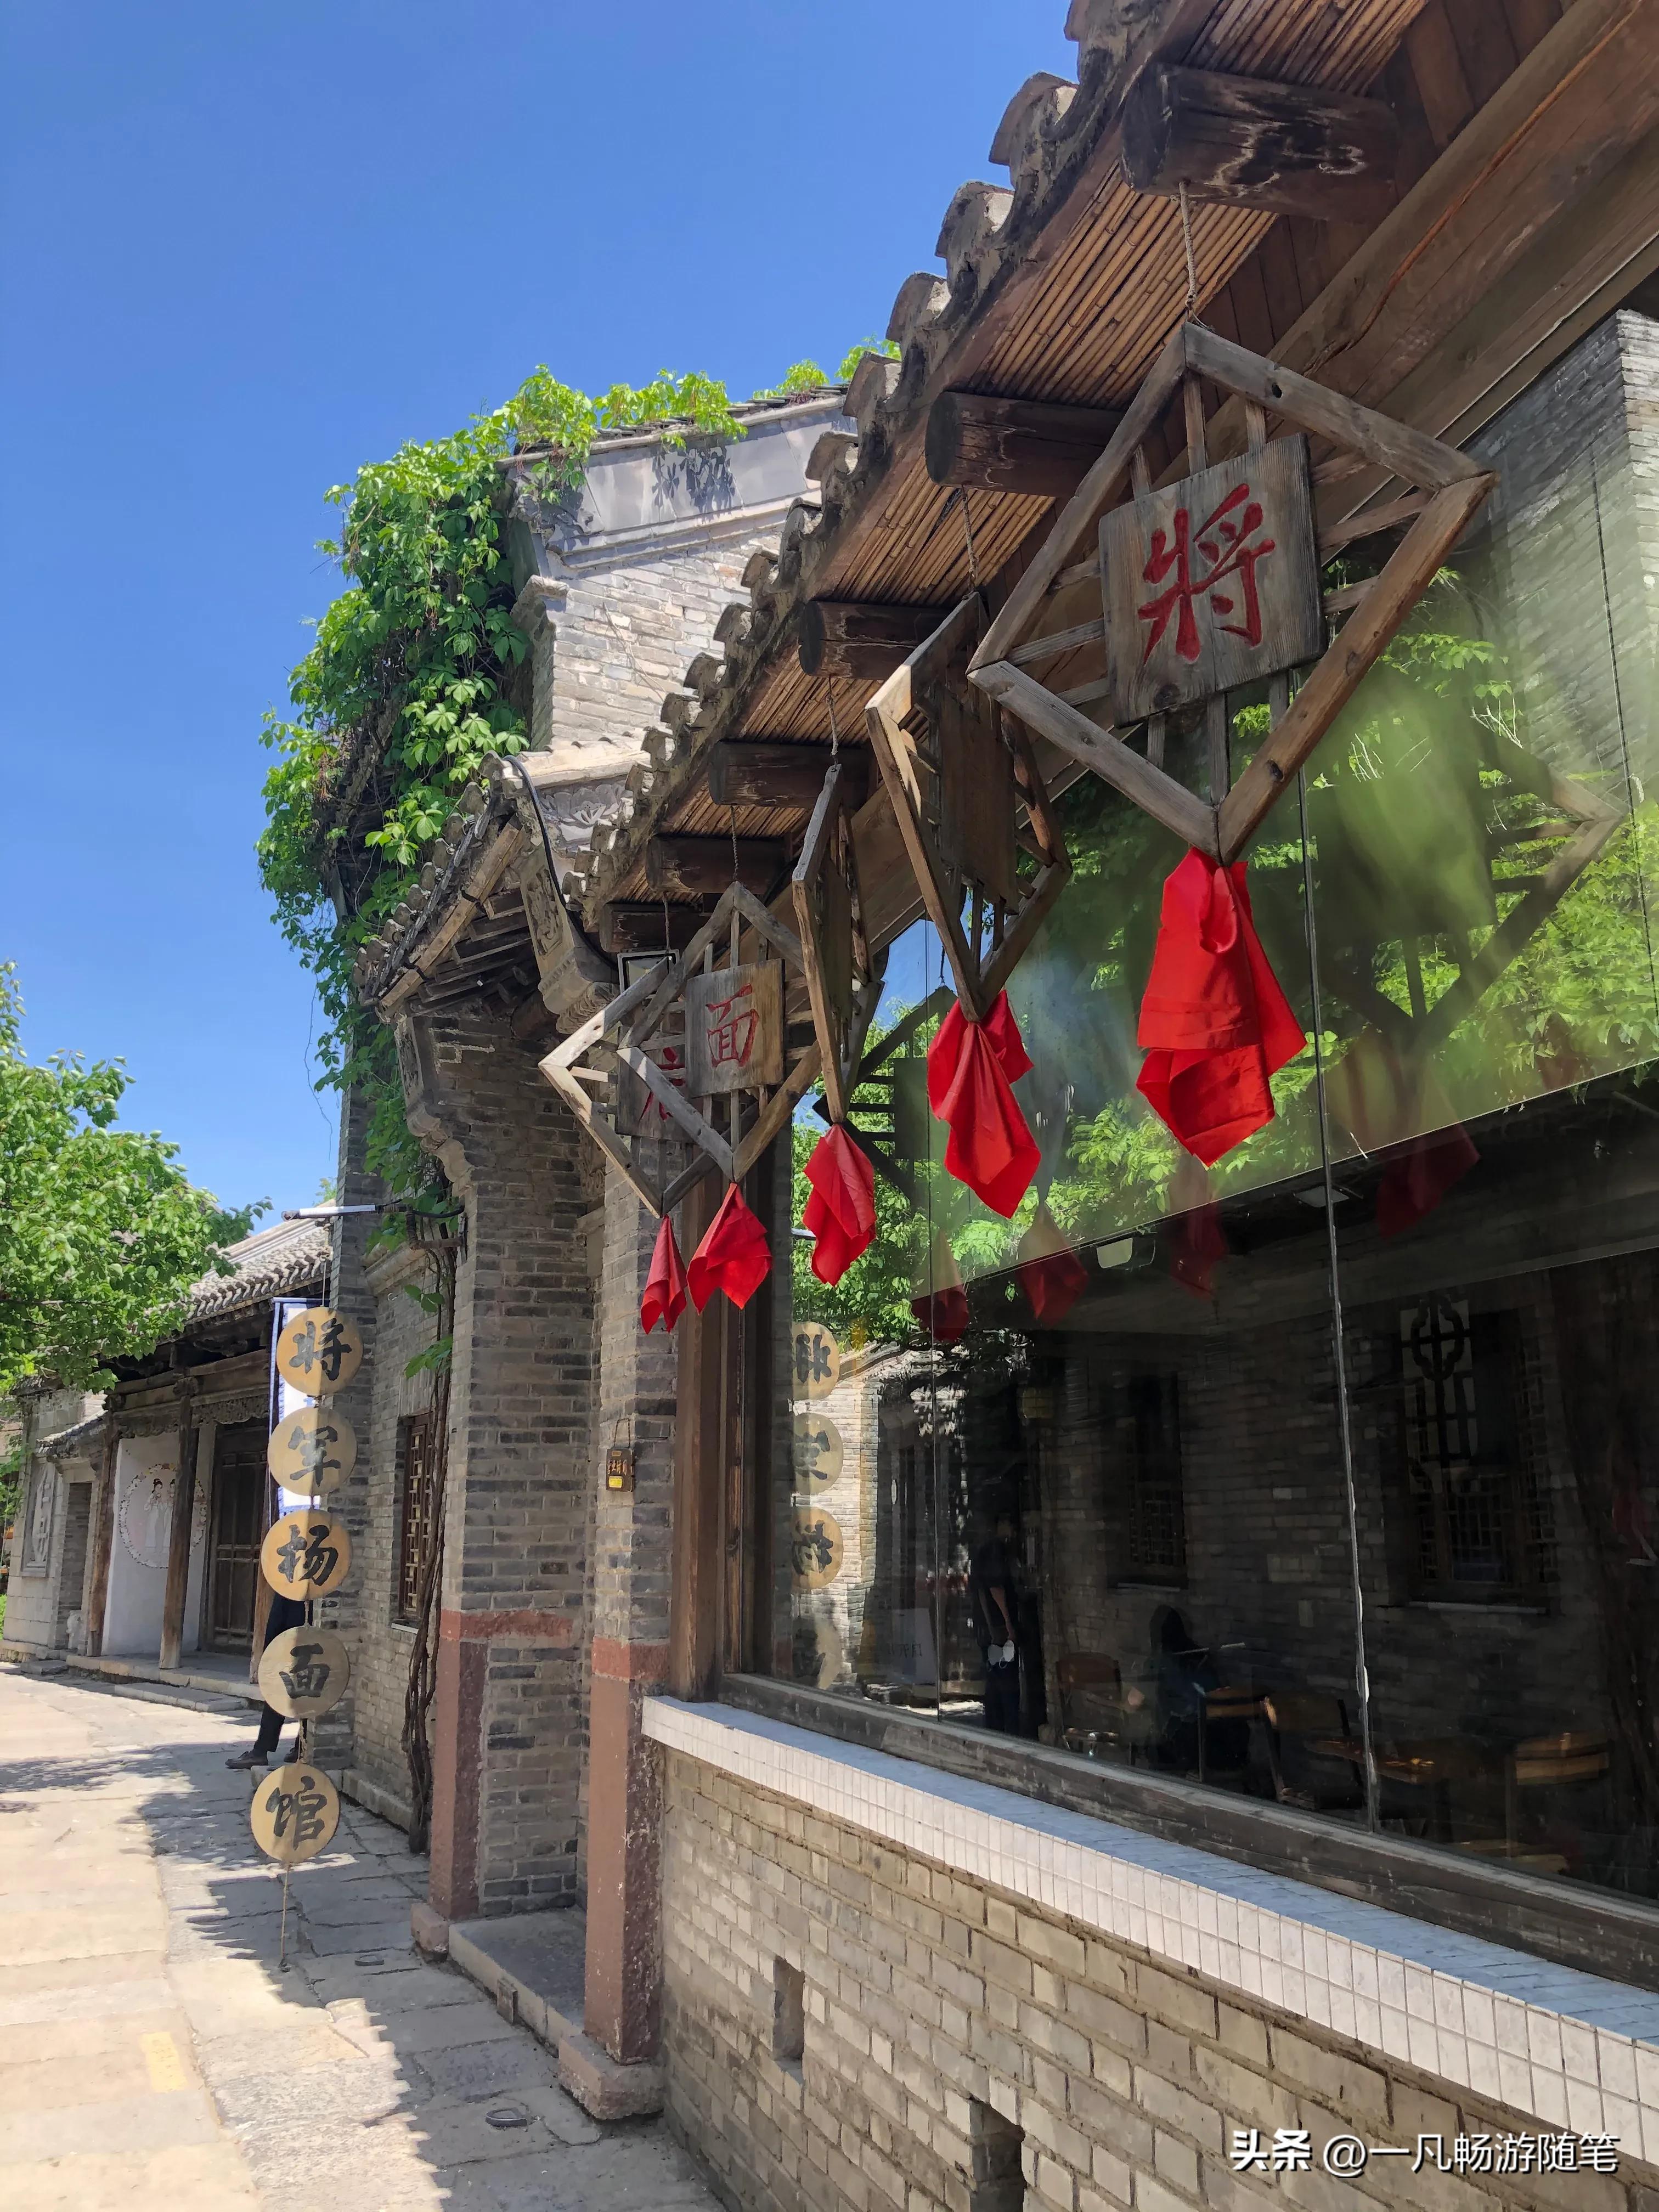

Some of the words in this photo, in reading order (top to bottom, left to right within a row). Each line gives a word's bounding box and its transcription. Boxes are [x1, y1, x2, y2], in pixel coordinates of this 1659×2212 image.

[1137, 483, 1276, 666] 将
[704, 983, 759, 1068] 面
[266, 1317, 352, 1850] 将军杨面馆
